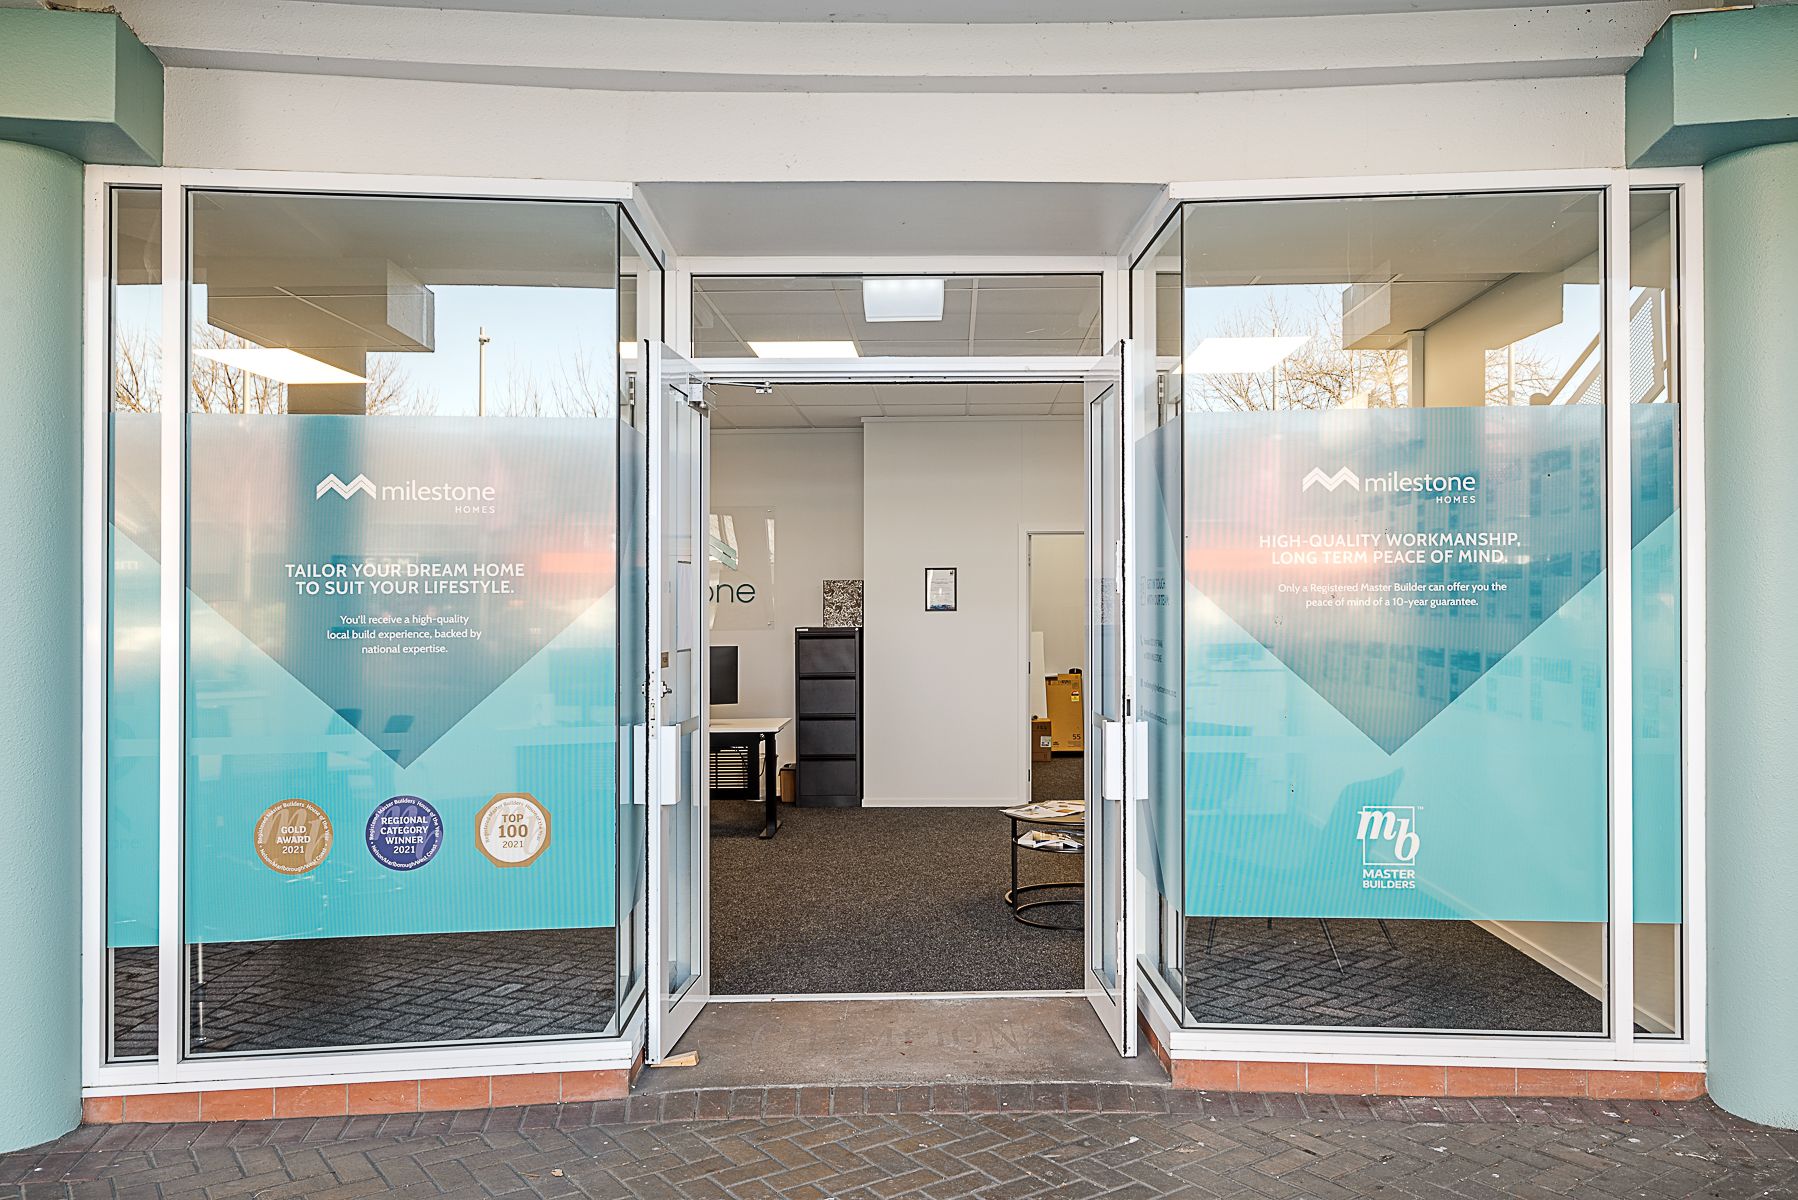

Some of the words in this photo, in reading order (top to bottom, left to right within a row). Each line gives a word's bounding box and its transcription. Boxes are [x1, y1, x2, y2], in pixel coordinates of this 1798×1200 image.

[1366, 472, 1475, 492] milestone
[382, 480, 495, 500] milestone
[1259, 533, 1381, 549] HIGH-QUALITY
[1386, 533, 1520, 547] WORKMANSHIP,
[1272, 551, 1317, 565] LONG
[1322, 551, 1368, 564] TERM
[1374, 550, 1425, 564] PEACE
[1431, 550, 1452, 563] OF
[1458, 549, 1507, 563] MIND.
[286, 564, 346, 578] TAILOR
[352, 563, 401, 577] YOUR
[408, 563, 467, 577] DREAM
[473, 563, 524, 577] HOME
[296, 581, 319, 595] TO
[325, 581, 364, 595] SUIT
[370, 580, 419, 594] YOUR
[425, 580, 514, 594] LIFESTYLE.
[1279, 584, 1300, 594] Only
[1310, 583, 1358, 594] Registered
[1361, 583, 1391, 592] Master
[1394, 583, 1427, 592] Builder
[1447, 582, 1469, 591] offer
[1472, 584, 1489, 594] you
[1491, 583, 1507, 591] the
[1306, 598, 1333, 609] peace
[1335, 597, 1344, 606] of
[1347, 597, 1370, 606] mind
[1373, 597, 1382, 606] of
[1393, 597, 1428, 608] 10-year
[1430, 597, 1479, 608] guarantee.
[340, 615, 366, 625] You'll
[369, 616, 402, 624] receive
[412, 614, 469, 625] high-quality
[327, 630, 350, 640] local
[352, 630, 375, 639] build
[378, 630, 432, 641] experience,
[434, 629, 468, 638] backed
[470, 629, 482, 640] by
[362, 645, 400, 654] national
[403, 645, 448, 655] expertise.
[381, 816, 428, 824] REGIONAL
[502, 814, 524, 822] TOP
[380, 826, 428, 834] CATEGORY
[498, 824, 528, 838] 100
[277, 836, 311, 844] AWARD
[385, 836, 424, 844] WINNER
[1363, 869, 1415, 879] MASTER
[1363, 881, 1415, 889] BUILDERS
